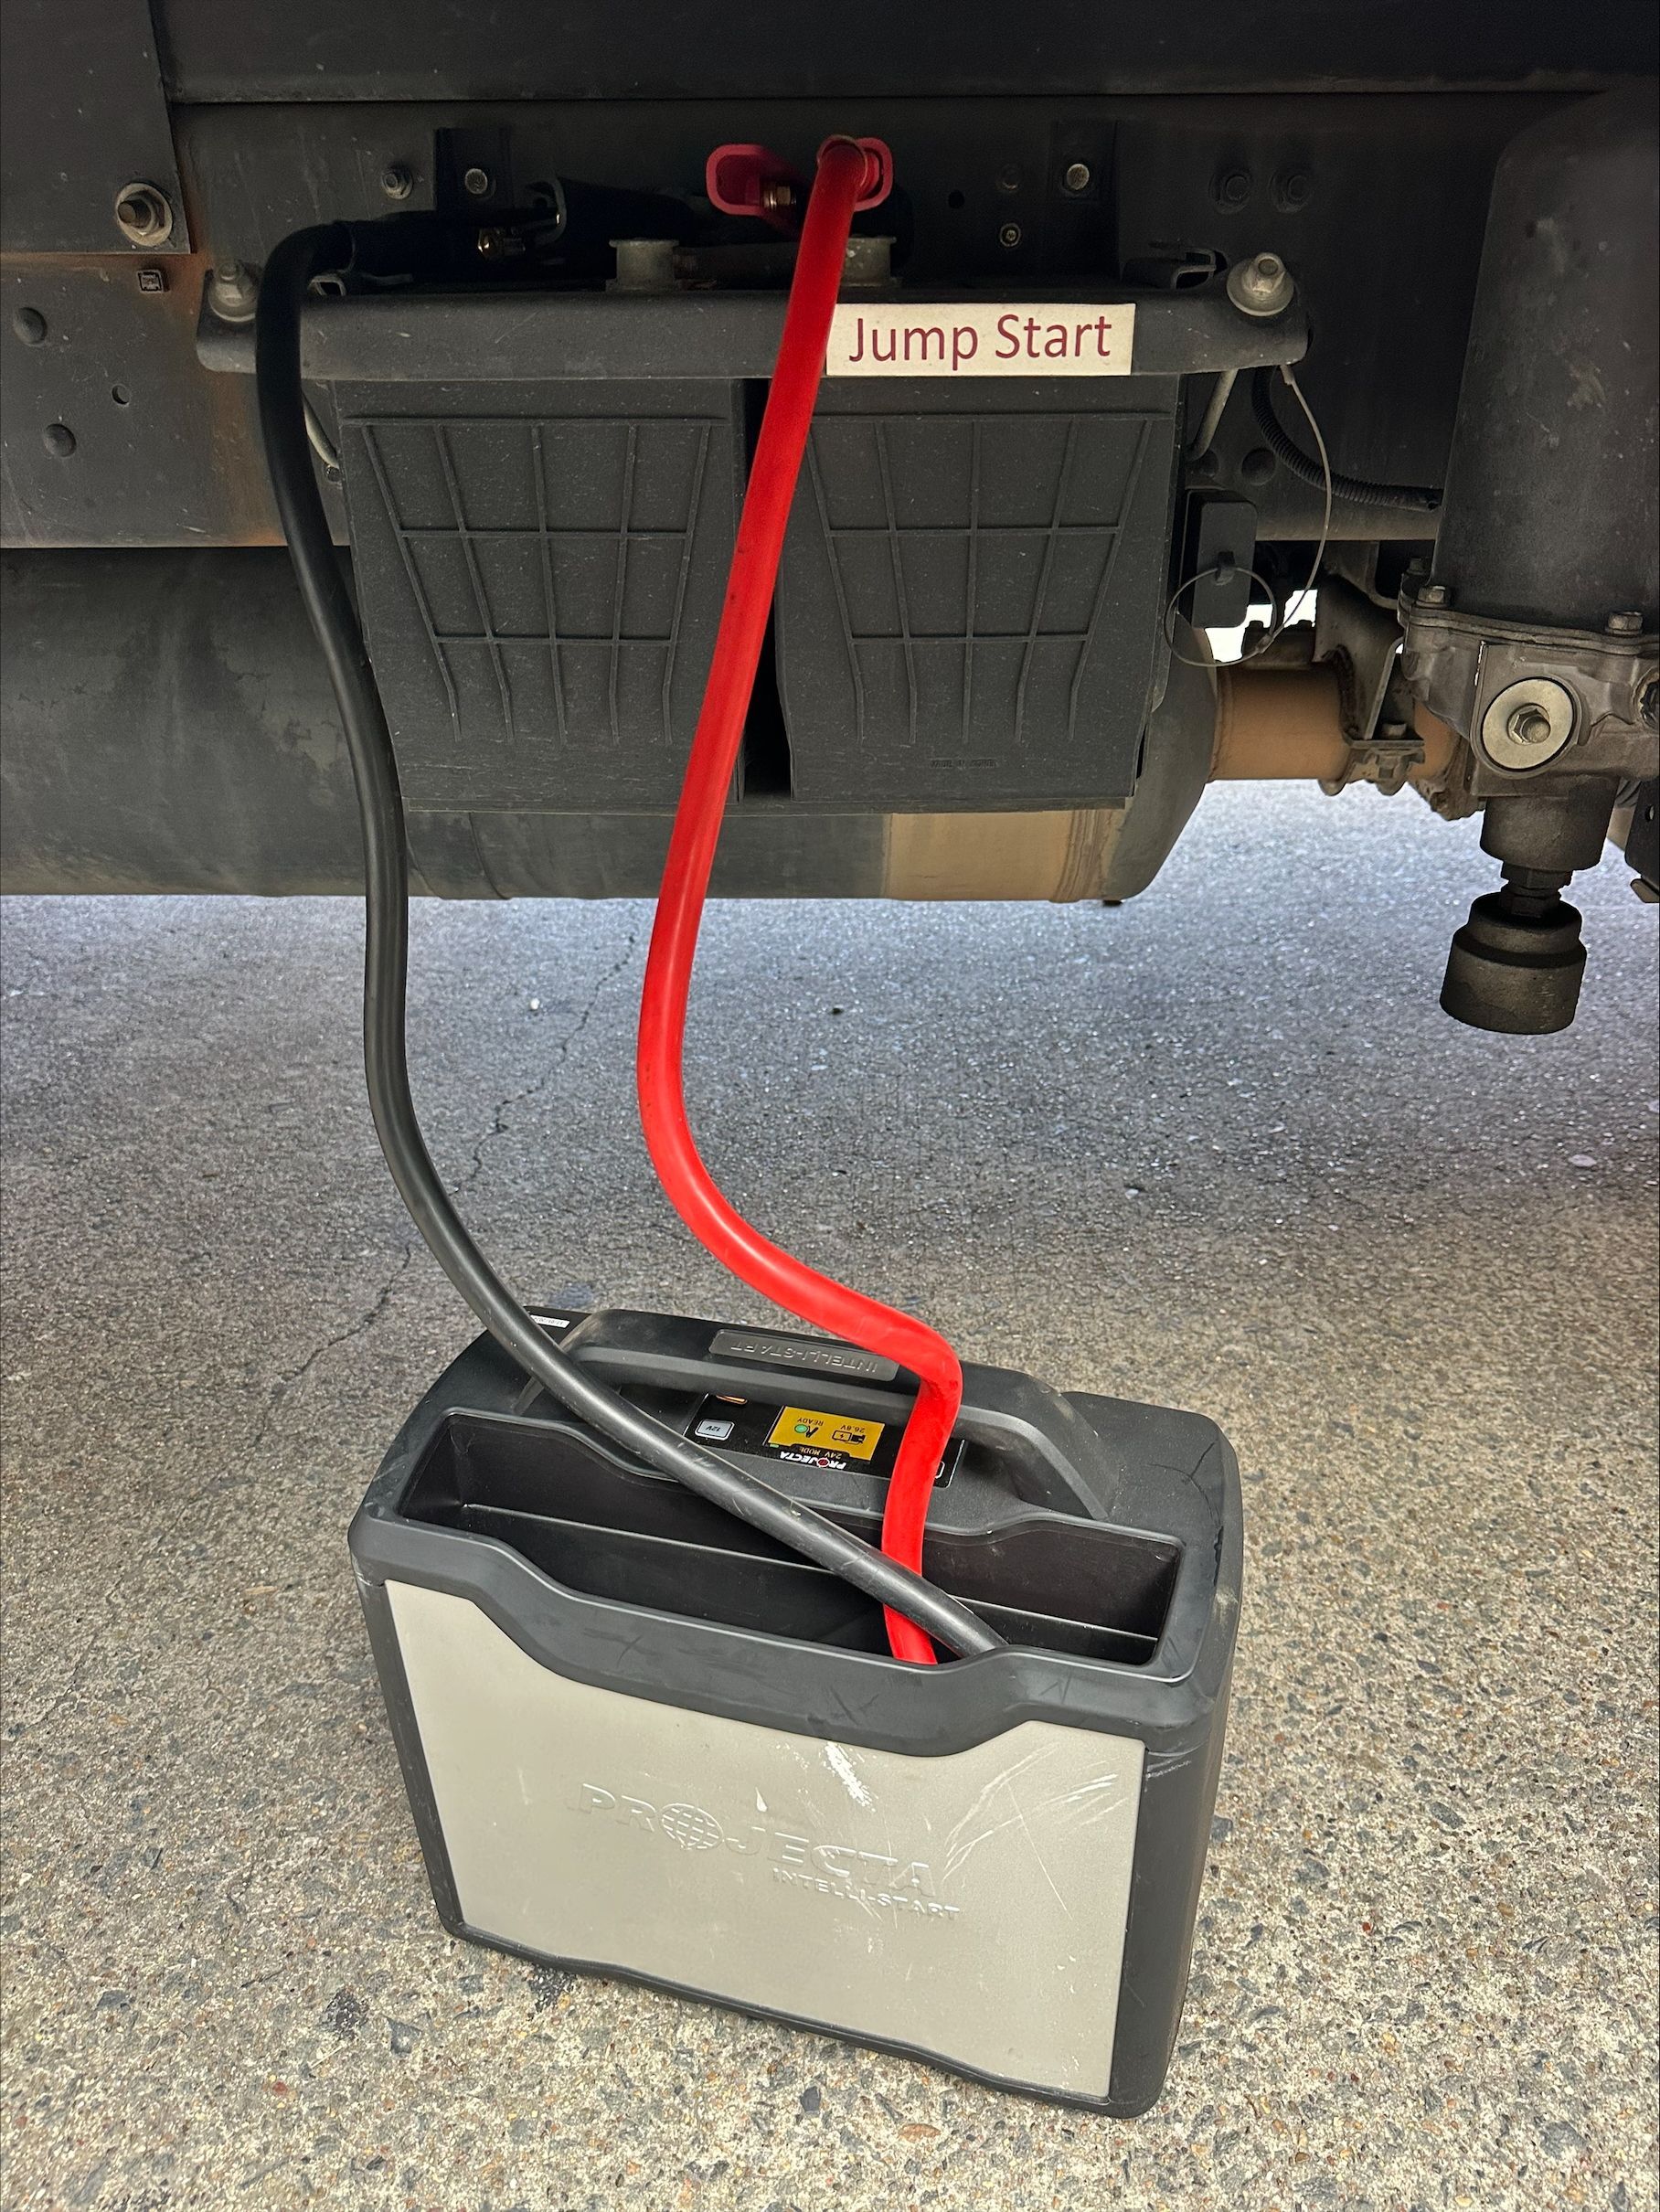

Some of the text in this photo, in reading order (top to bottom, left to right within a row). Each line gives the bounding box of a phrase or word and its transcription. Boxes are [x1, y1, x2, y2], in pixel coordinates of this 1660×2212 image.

[848, 314, 1112, 371] Jump Start
[730, 1342, 878, 1374] INTELLI-START
[705, 1425, 722, 1433] 12V
[797, 1417, 825, 1427] READY
[779, 1450, 847, 1471] PROJECTA
[799, 1446, 843, 1460] 24V MODE
[569, 1782, 936, 1898] PROJECTA
[771, 1867, 961, 1920] INTELLI-START
